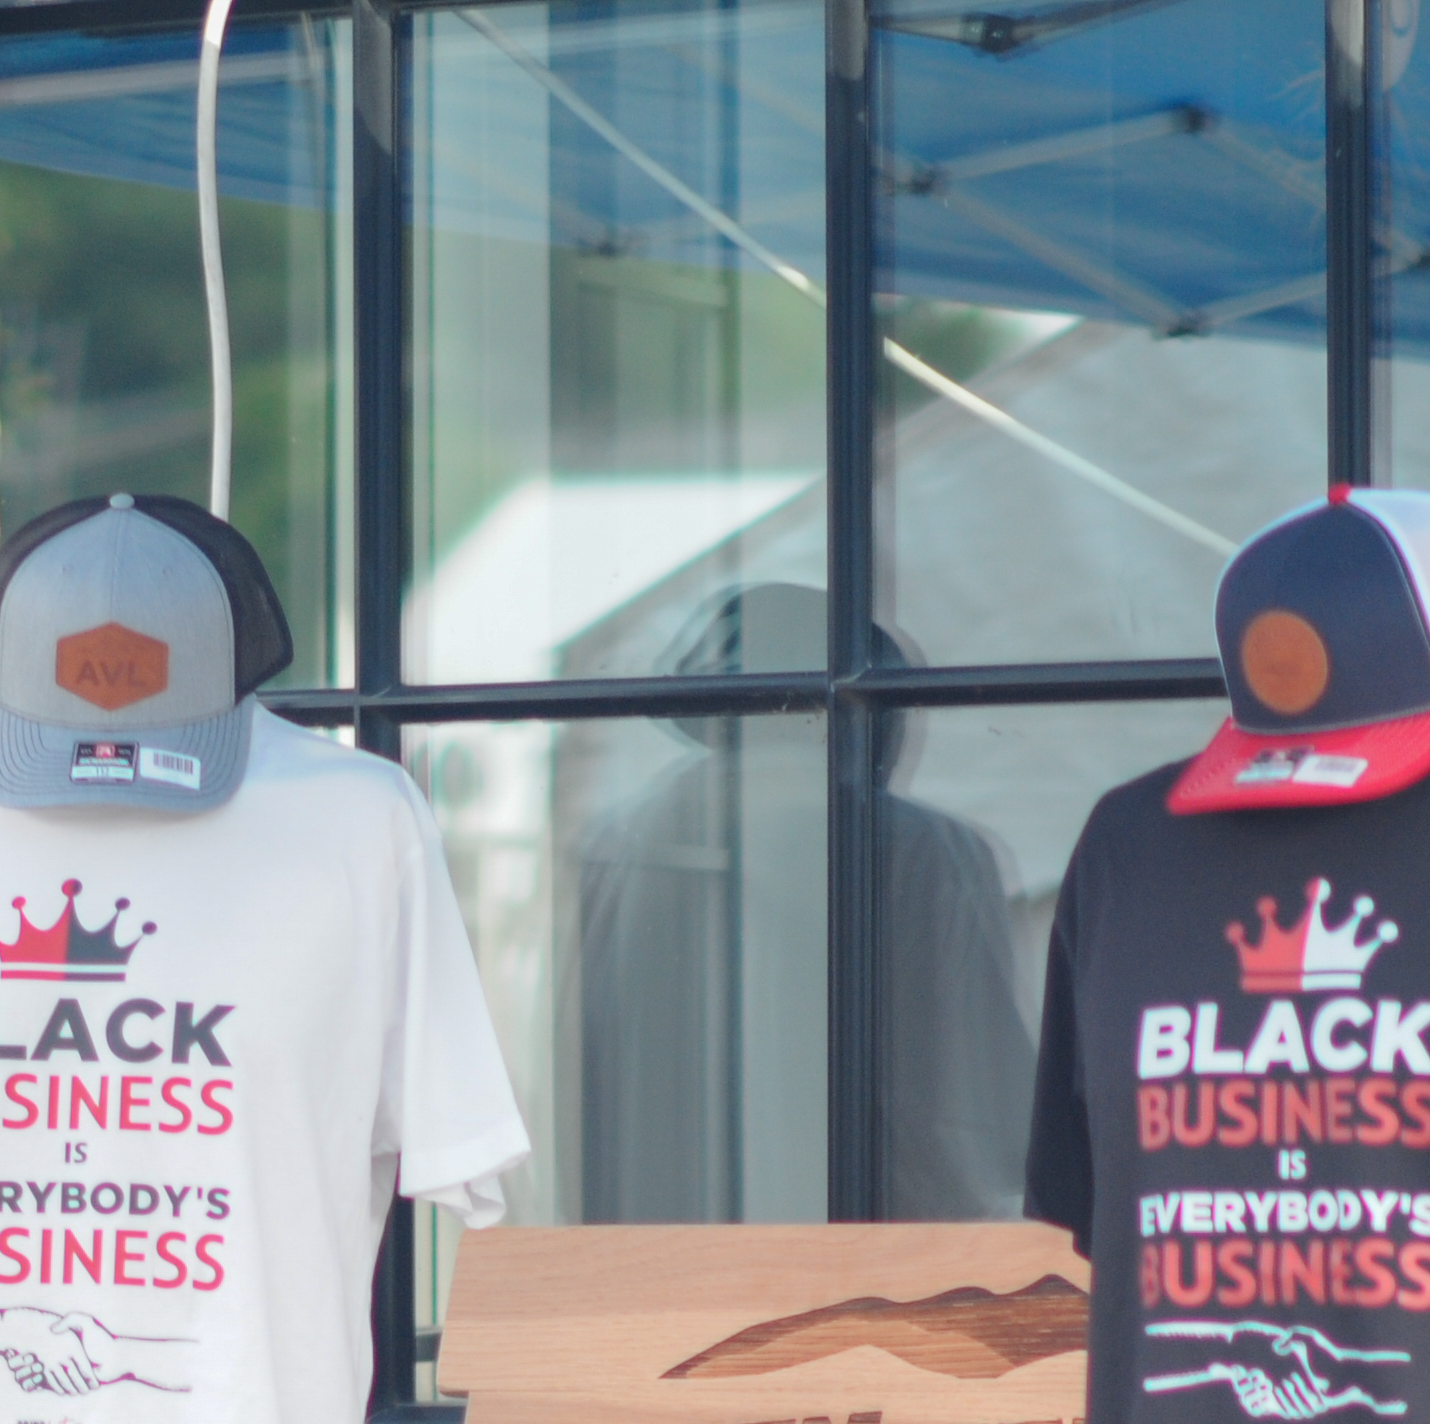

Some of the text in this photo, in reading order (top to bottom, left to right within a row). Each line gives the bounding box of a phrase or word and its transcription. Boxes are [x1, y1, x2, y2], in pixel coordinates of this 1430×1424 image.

[75, 660, 148, 687] AVL
[64, 1142, 88, 1163] IS
[1278, 1150, 1306, 1179] IS
